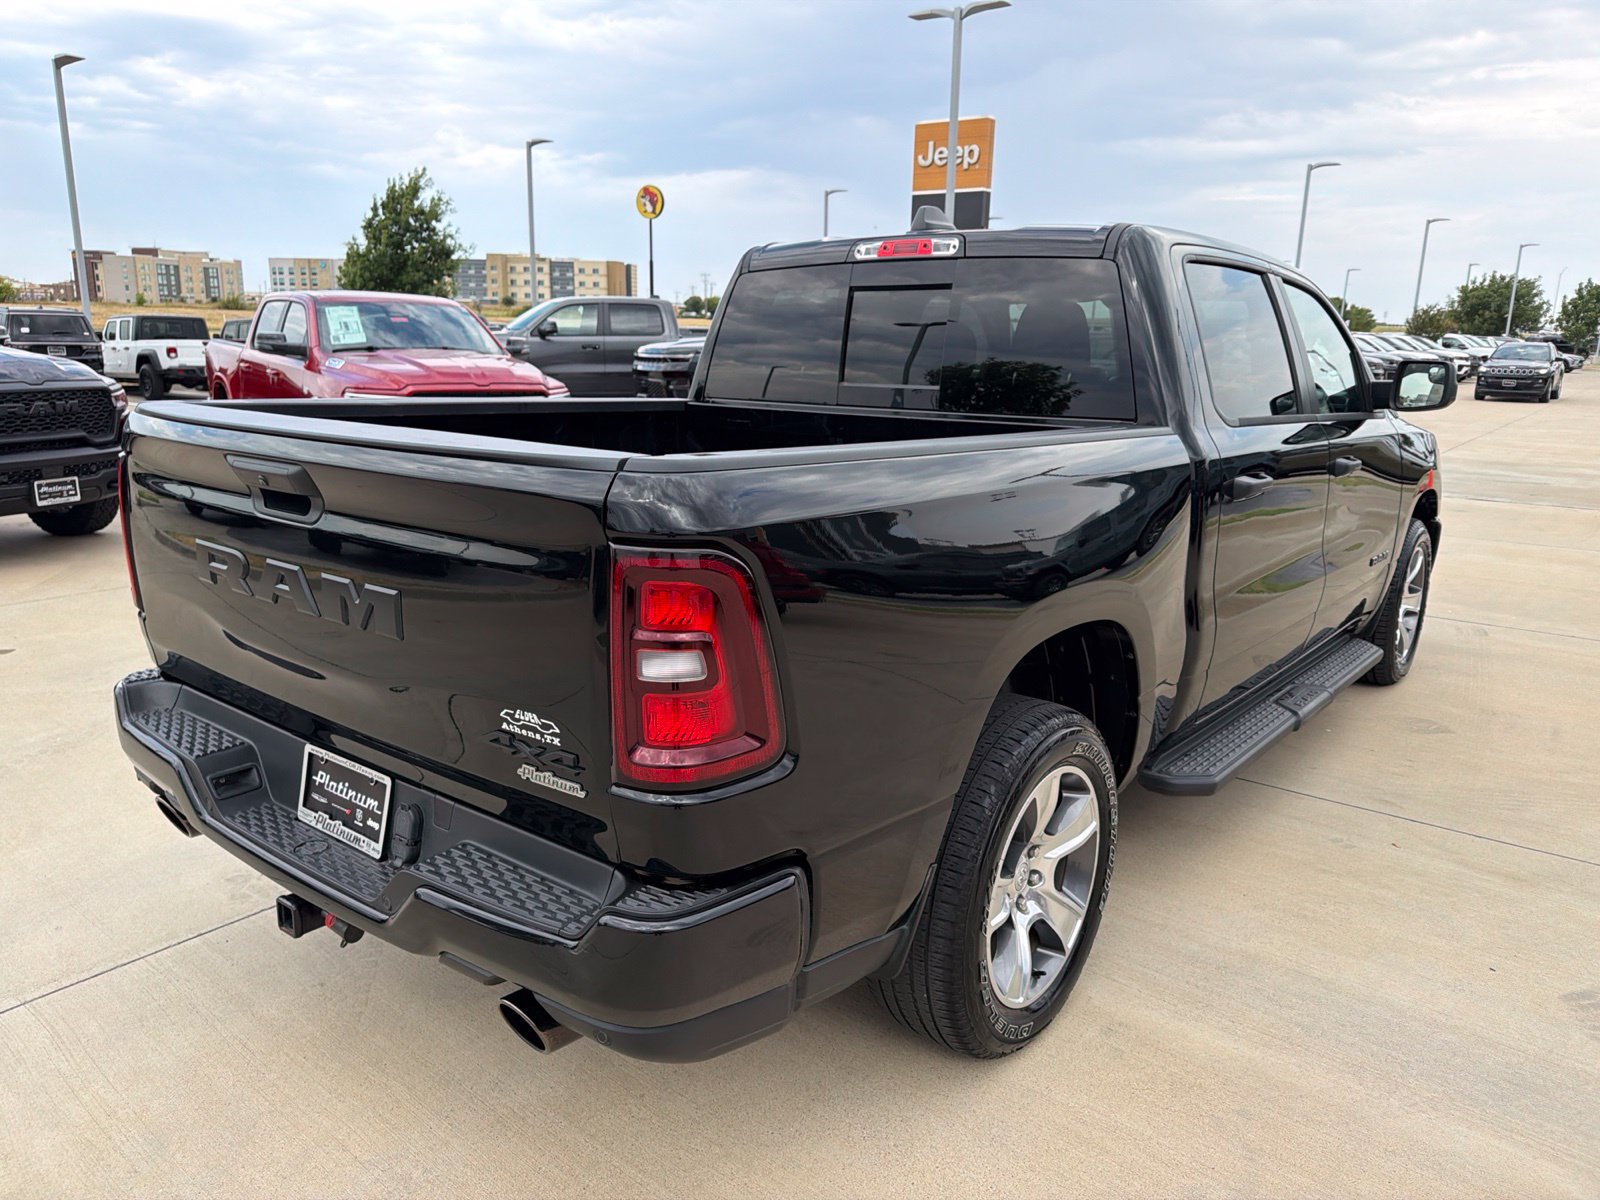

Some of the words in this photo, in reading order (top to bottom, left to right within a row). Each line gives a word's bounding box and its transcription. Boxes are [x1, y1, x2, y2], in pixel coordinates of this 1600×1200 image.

[195, 538, 404, 640] RAM
[312, 770, 382, 815] Platinum
[516, 763, 588, 799] Platinum
[315, 814, 365, 850] Platinum
